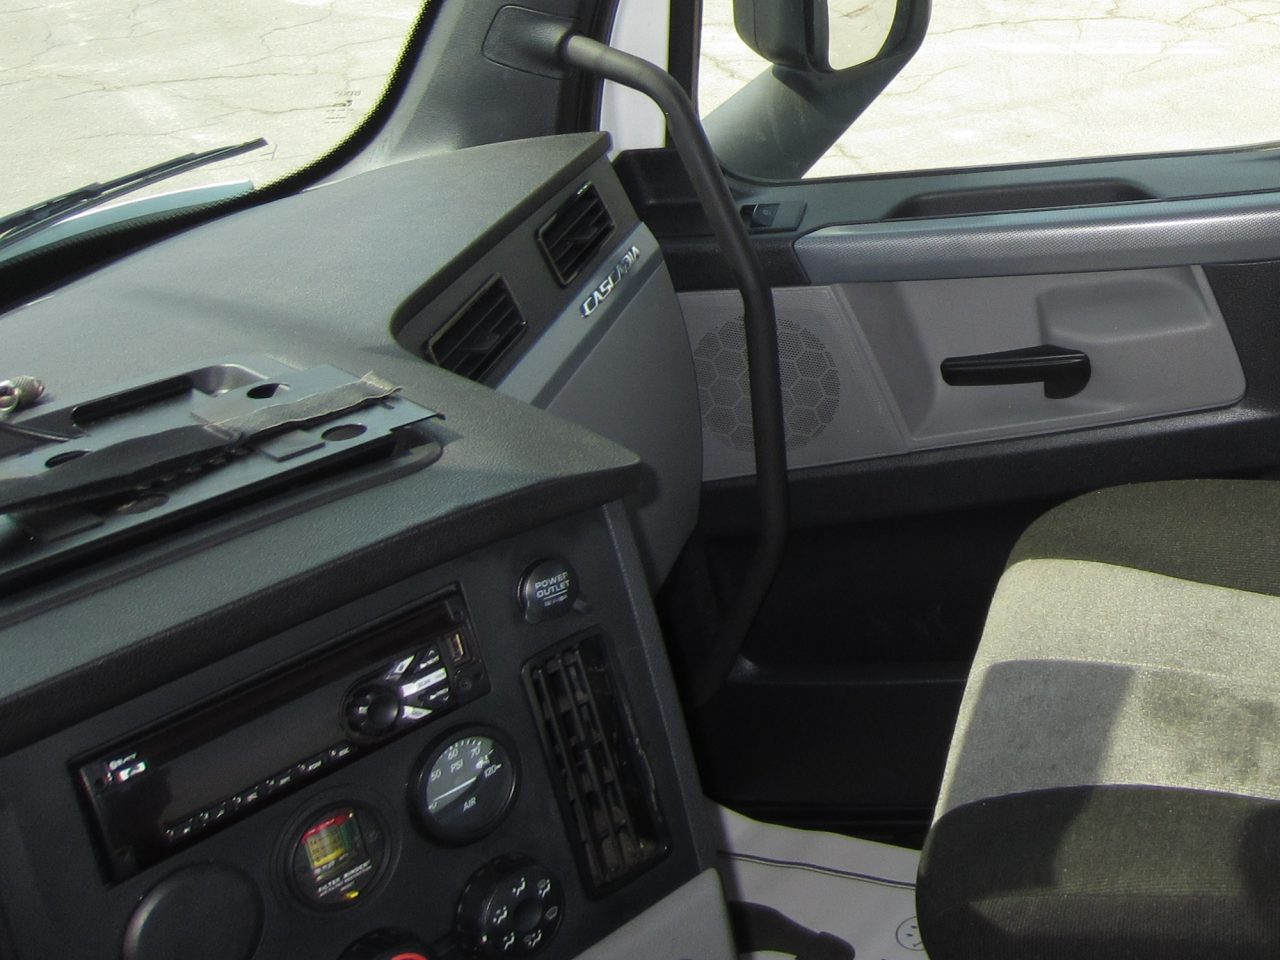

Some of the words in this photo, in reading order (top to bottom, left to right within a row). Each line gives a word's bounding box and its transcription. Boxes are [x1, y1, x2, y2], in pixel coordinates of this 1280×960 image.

[536, 580, 570, 598] OUTLET
[447, 748, 459, 760] 60
[470, 746, 481, 758] 70
[450, 758, 464, 773] PSI
[431, 768, 442, 782] 50
[463, 796, 477, 813] AIR
